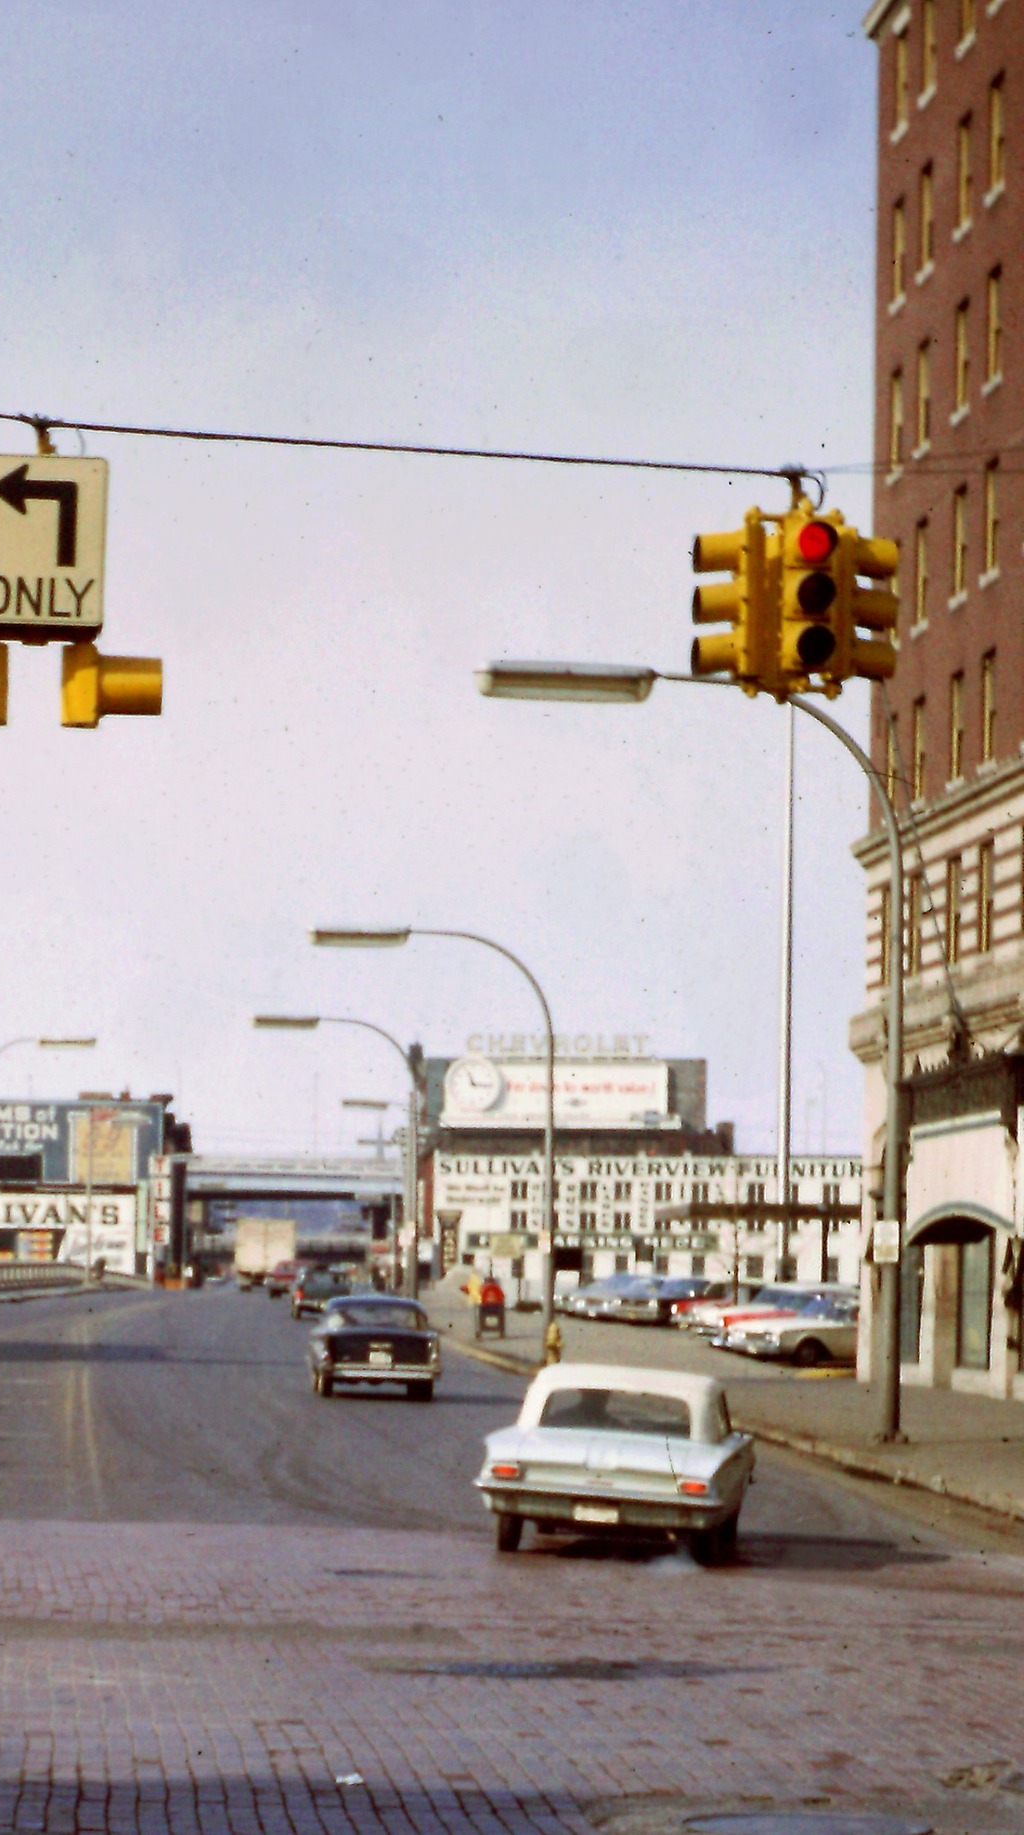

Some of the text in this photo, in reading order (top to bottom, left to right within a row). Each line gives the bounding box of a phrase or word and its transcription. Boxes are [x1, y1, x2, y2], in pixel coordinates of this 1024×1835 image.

[466, 1033, 651, 1054] CHEVROLET
[35, 1105, 57, 1121] of
[440, 1159, 574, 1176] SULLIVA'S
[587, 1161, 727, 1177] RIVERVIEW
[153, 1158, 166, 1242] TILE
[552, 1234, 633, 1248] ARKING
